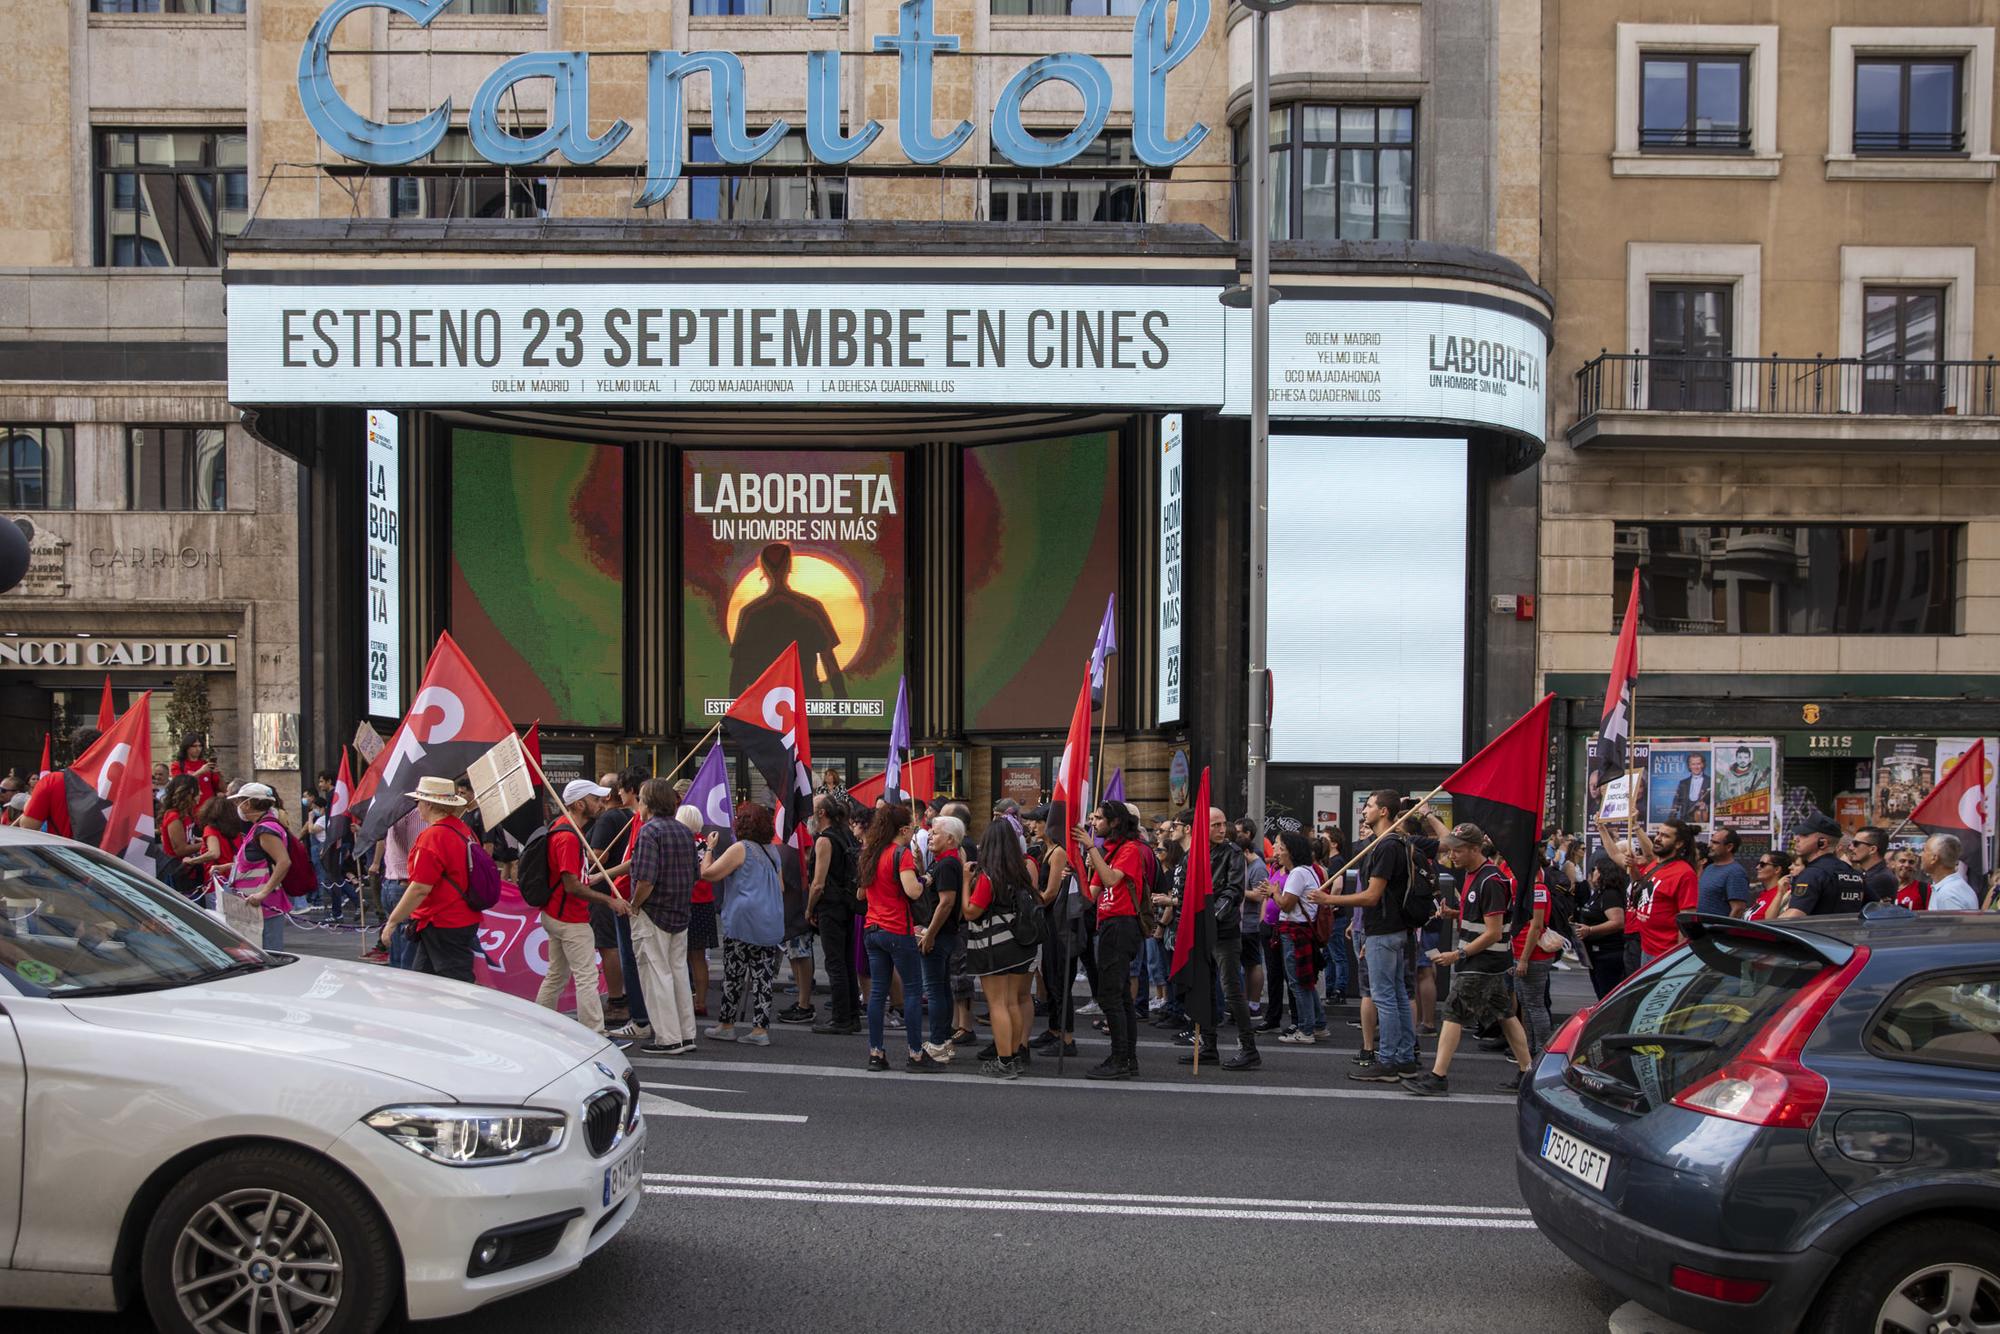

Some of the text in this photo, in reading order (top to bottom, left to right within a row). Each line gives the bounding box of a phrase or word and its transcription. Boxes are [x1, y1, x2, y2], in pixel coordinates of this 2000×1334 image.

[297, 0, 1211, 207] Capitol
[282, 308, 1169, 370] ESTRENO 23 SEPTIEMBRE EN CINES
[1305, 332, 1381, 346] GOLEM MADRID
[1317, 351, 1379, 364] YELMO IDEAL
[1429, 333, 1540, 393] LABORDETA
[491, 379, 570, 393] GOLEM MADRID
[596, 379, 662, 393] YELMO IDEAL
[689, 379, 794, 393] ZOCO MAJADAHONDA
[821, 379, 955, 393] LA DEHESA CUADERNILLOS
[1307, 369, 1381, 383] MAJADAHONDA
[1429, 375, 1441, 388] UN
[1444, 376, 1478, 392] HOMBRE
[1479, 382, 1491, 394] SIN
[1309, 388, 1381, 402] CUADERNILLOS
[369, 460, 386, 501] LA
[694, 472, 897, 515] LABORDETA
[1169, 463, 1181, 498] UN
[369, 501, 398, 547] BOR
[712, 516, 877, 541] UN HOMBRE SIN MÁS
[1163, 497, 1181, 534] HOM
[1165, 530, 1181, 564] BRE
[369, 544, 388, 584] DE
[1167, 562, 1181, 596] SIN
[369, 585, 389, 625] TA
[86, 641, 234, 667] CAPITOL
[370, 650, 388, 683] 23
[1167, 654, 1179, 688] 23
[838, 702, 851, 715] EN
[853, 702, 881, 715] CINES
[1809, 735, 1852, 748] IRIS
[1547, 1131, 1607, 1184] 7502 GFT
